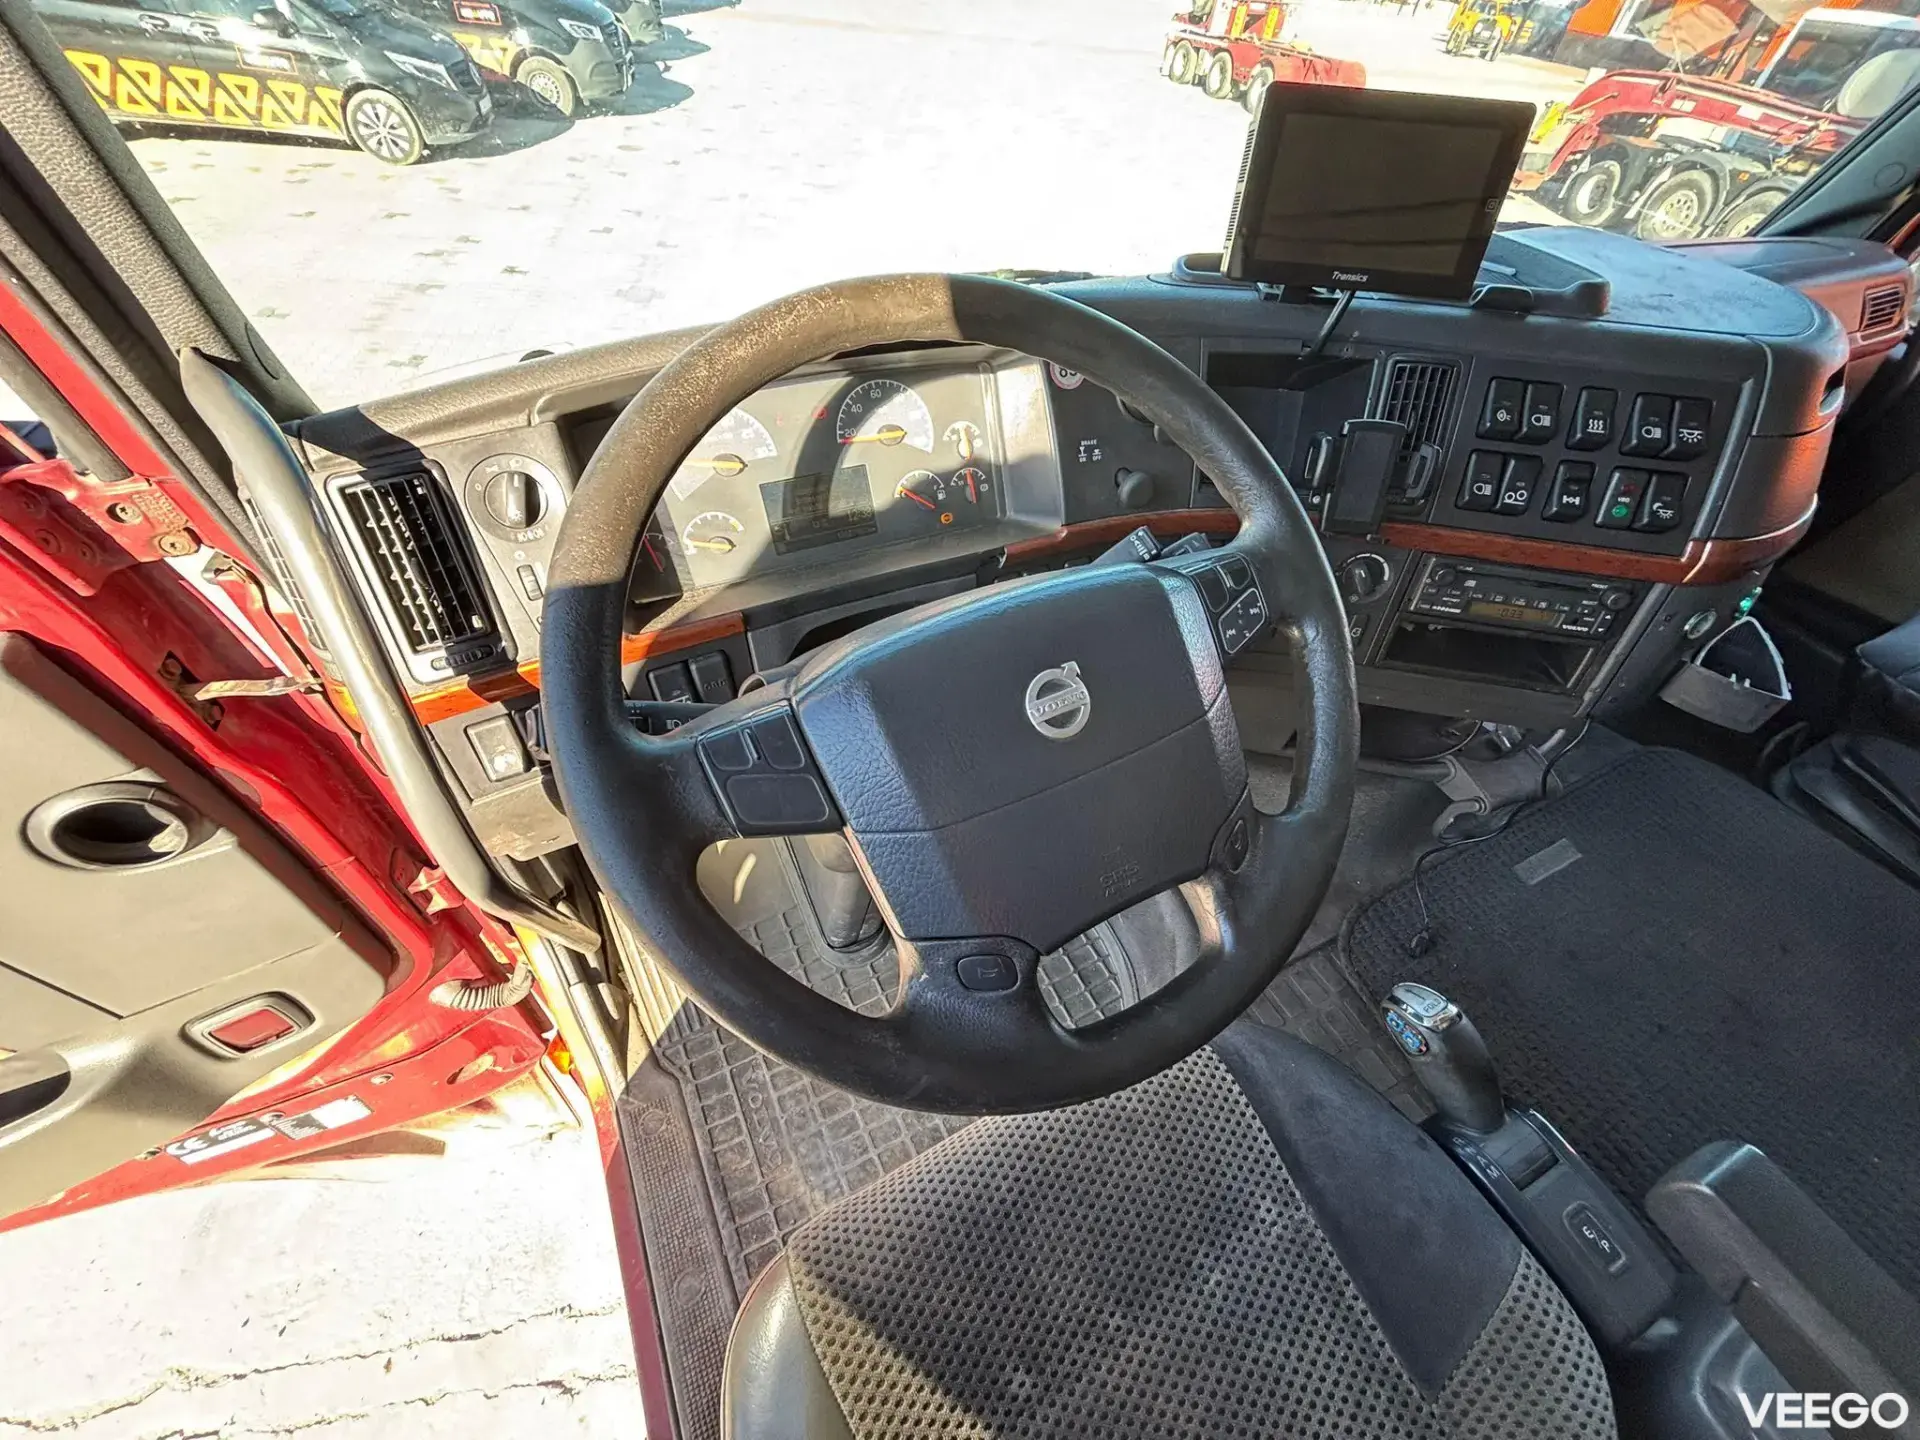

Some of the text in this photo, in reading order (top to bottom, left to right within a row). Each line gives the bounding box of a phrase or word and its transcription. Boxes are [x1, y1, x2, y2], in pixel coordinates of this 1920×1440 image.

[1332, 271, 1369, 282] Transics
[870, 389, 882, 399] 60
[851, 403, 863, 414] 40
[844, 428, 857, 437] 20
[1562, 624, 1589, 632] VOLVO
[1029, 689, 1088, 718] VOLVO
